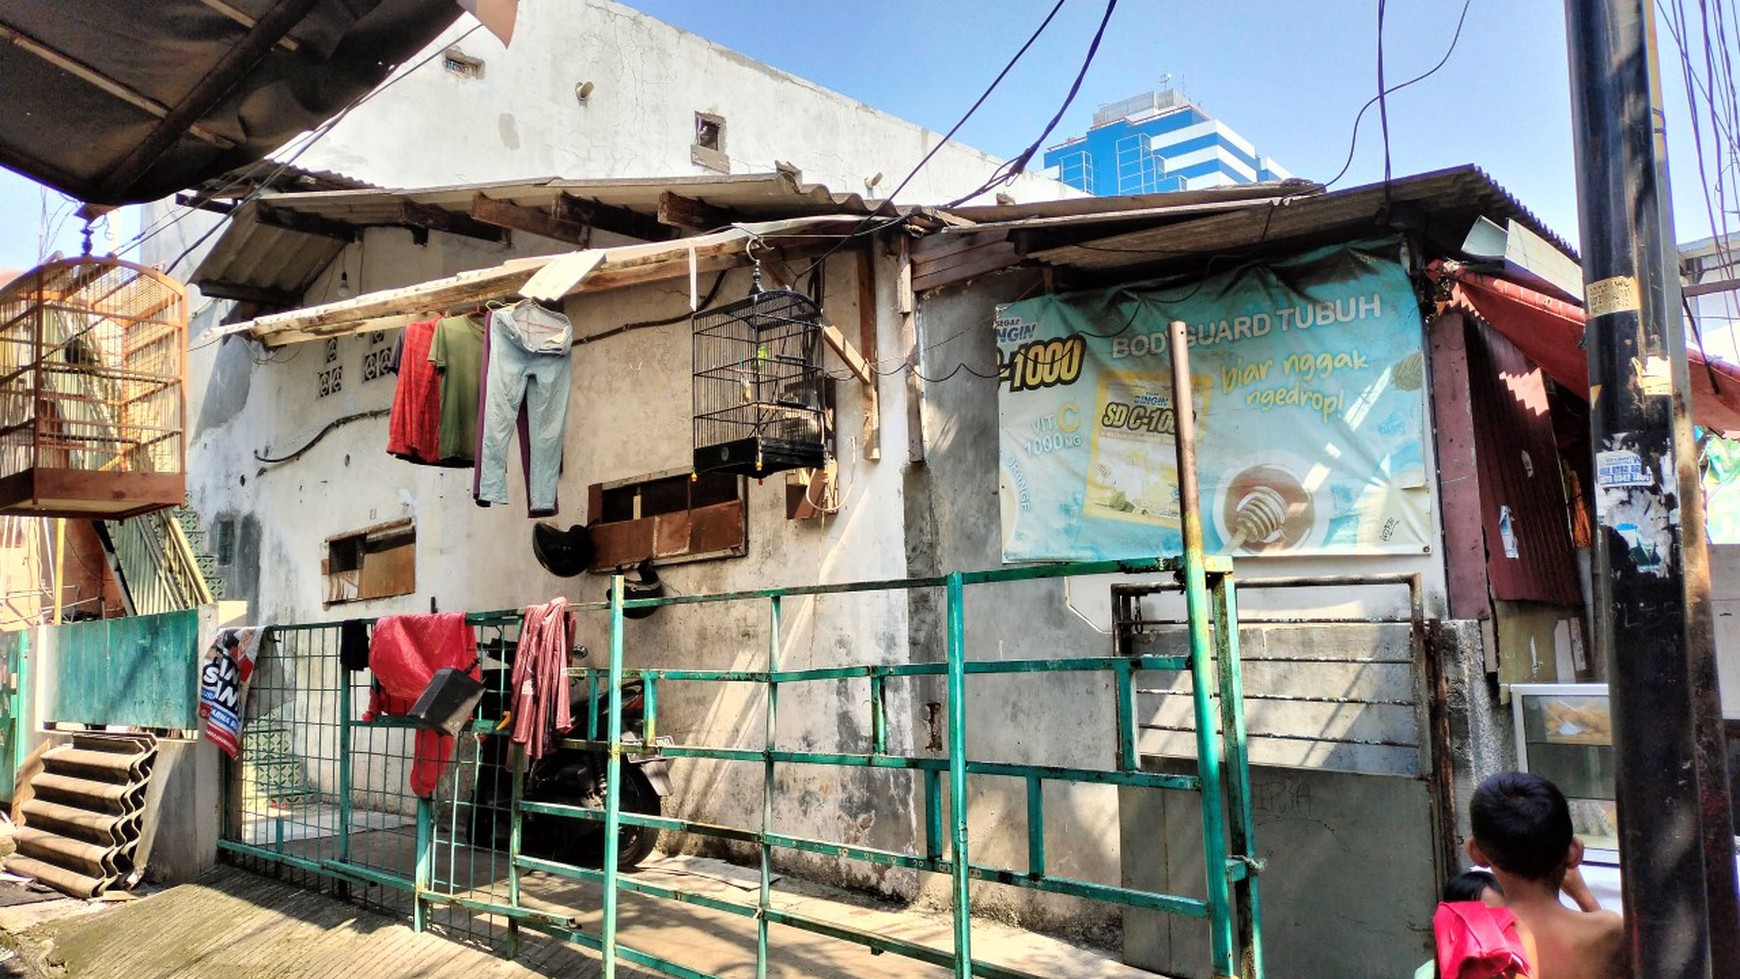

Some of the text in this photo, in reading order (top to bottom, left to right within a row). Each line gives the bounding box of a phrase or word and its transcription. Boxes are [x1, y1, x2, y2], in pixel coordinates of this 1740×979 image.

[1111, 293, 1381, 359] BODGUARD TUBUH
[997, 334, 1086, 392] -1000
[1222, 349, 1369, 394] biar nggak
[1031, 402, 1081, 435] VIT C
[1246, 386, 1345, 423] ngedrop!
[1006, 455, 1032, 513] ORANGE
